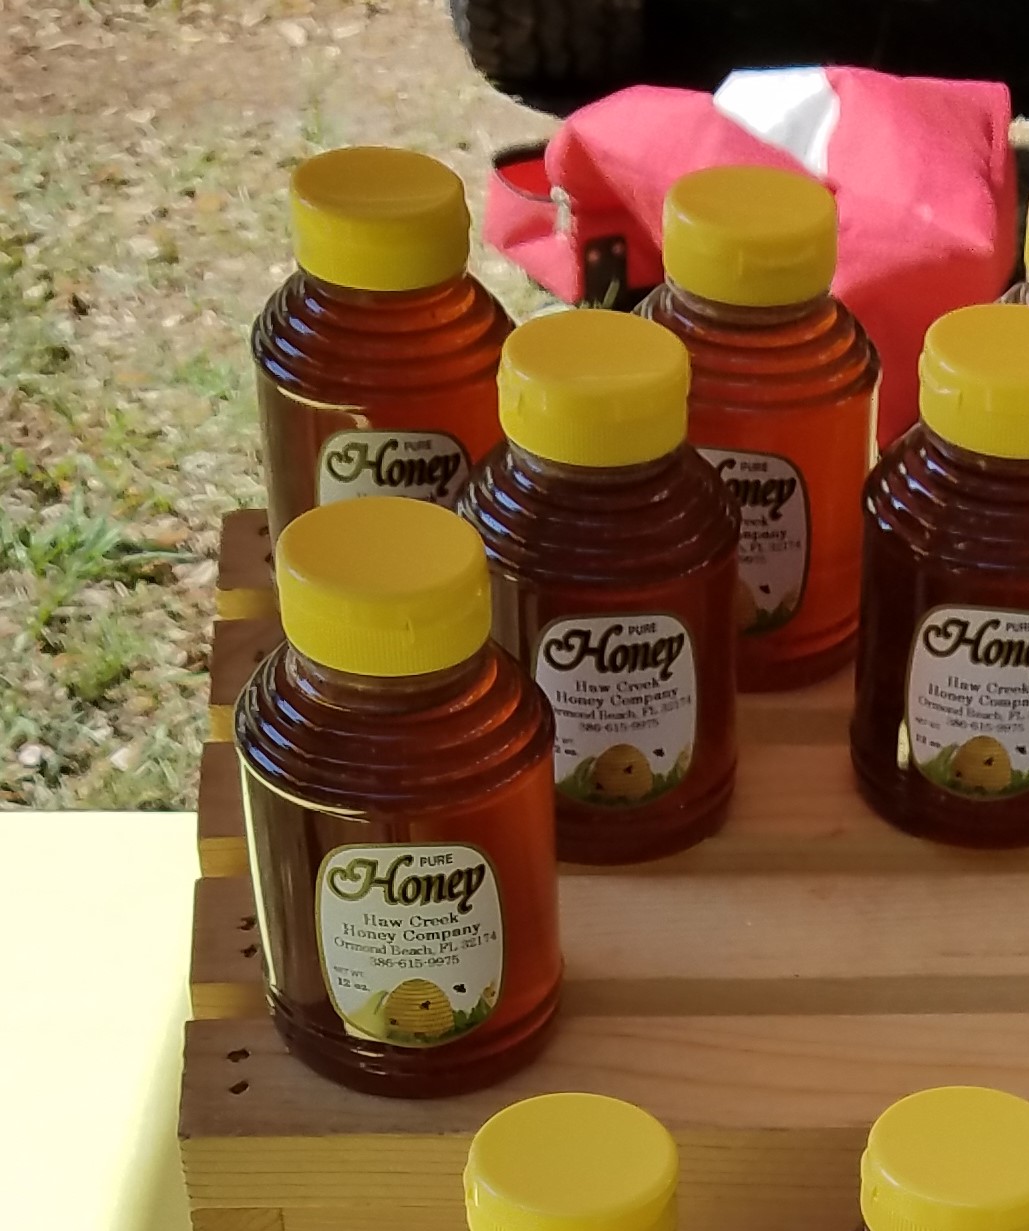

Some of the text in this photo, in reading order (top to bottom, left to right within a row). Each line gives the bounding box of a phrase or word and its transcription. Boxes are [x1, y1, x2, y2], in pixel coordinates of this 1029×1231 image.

[326, 439, 460, 496] Honey
[628, 622, 656, 635] PURE
[543, 624, 684, 681] Honey
[576, 678, 660, 693] Haw Creek
[929, 683, 973, 706] Honey
[948, 675, 1029, 694] Haw Creek
[556, 687, 678, 709] Honey Company
[420, 853, 453, 867] PURE
[326, 854, 485, 915] Honey
[363, 913, 459, 928] Haw Creek
[343, 923, 481, 944] Honey Company
[334, 937, 386, 955] Ormond
[440, 944, 458, 953] FL
